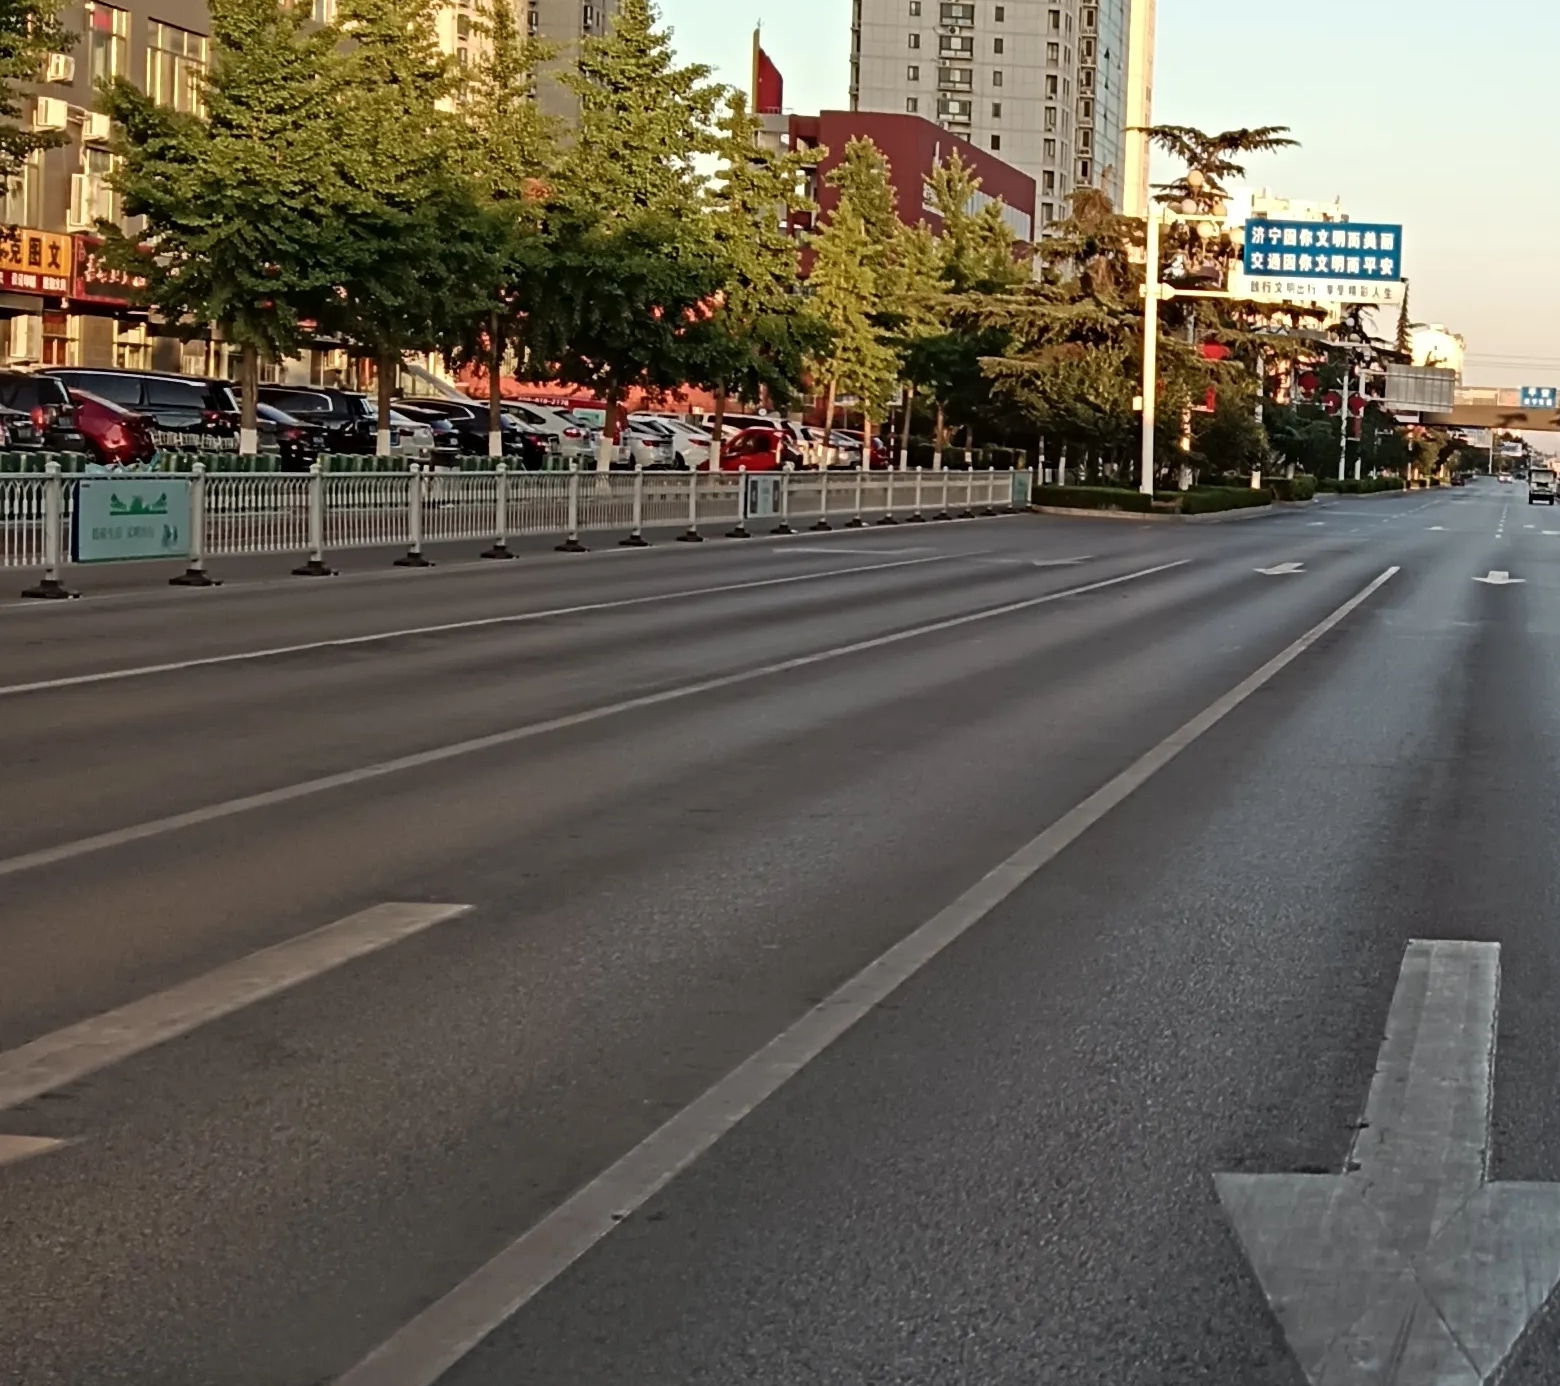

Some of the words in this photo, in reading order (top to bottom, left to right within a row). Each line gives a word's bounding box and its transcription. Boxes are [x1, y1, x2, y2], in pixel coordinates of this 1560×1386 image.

[1251, 226, 1395, 250] 济宁因你文明而美丽
[1250, 252, 1394, 276] 交通因你文明而平安
